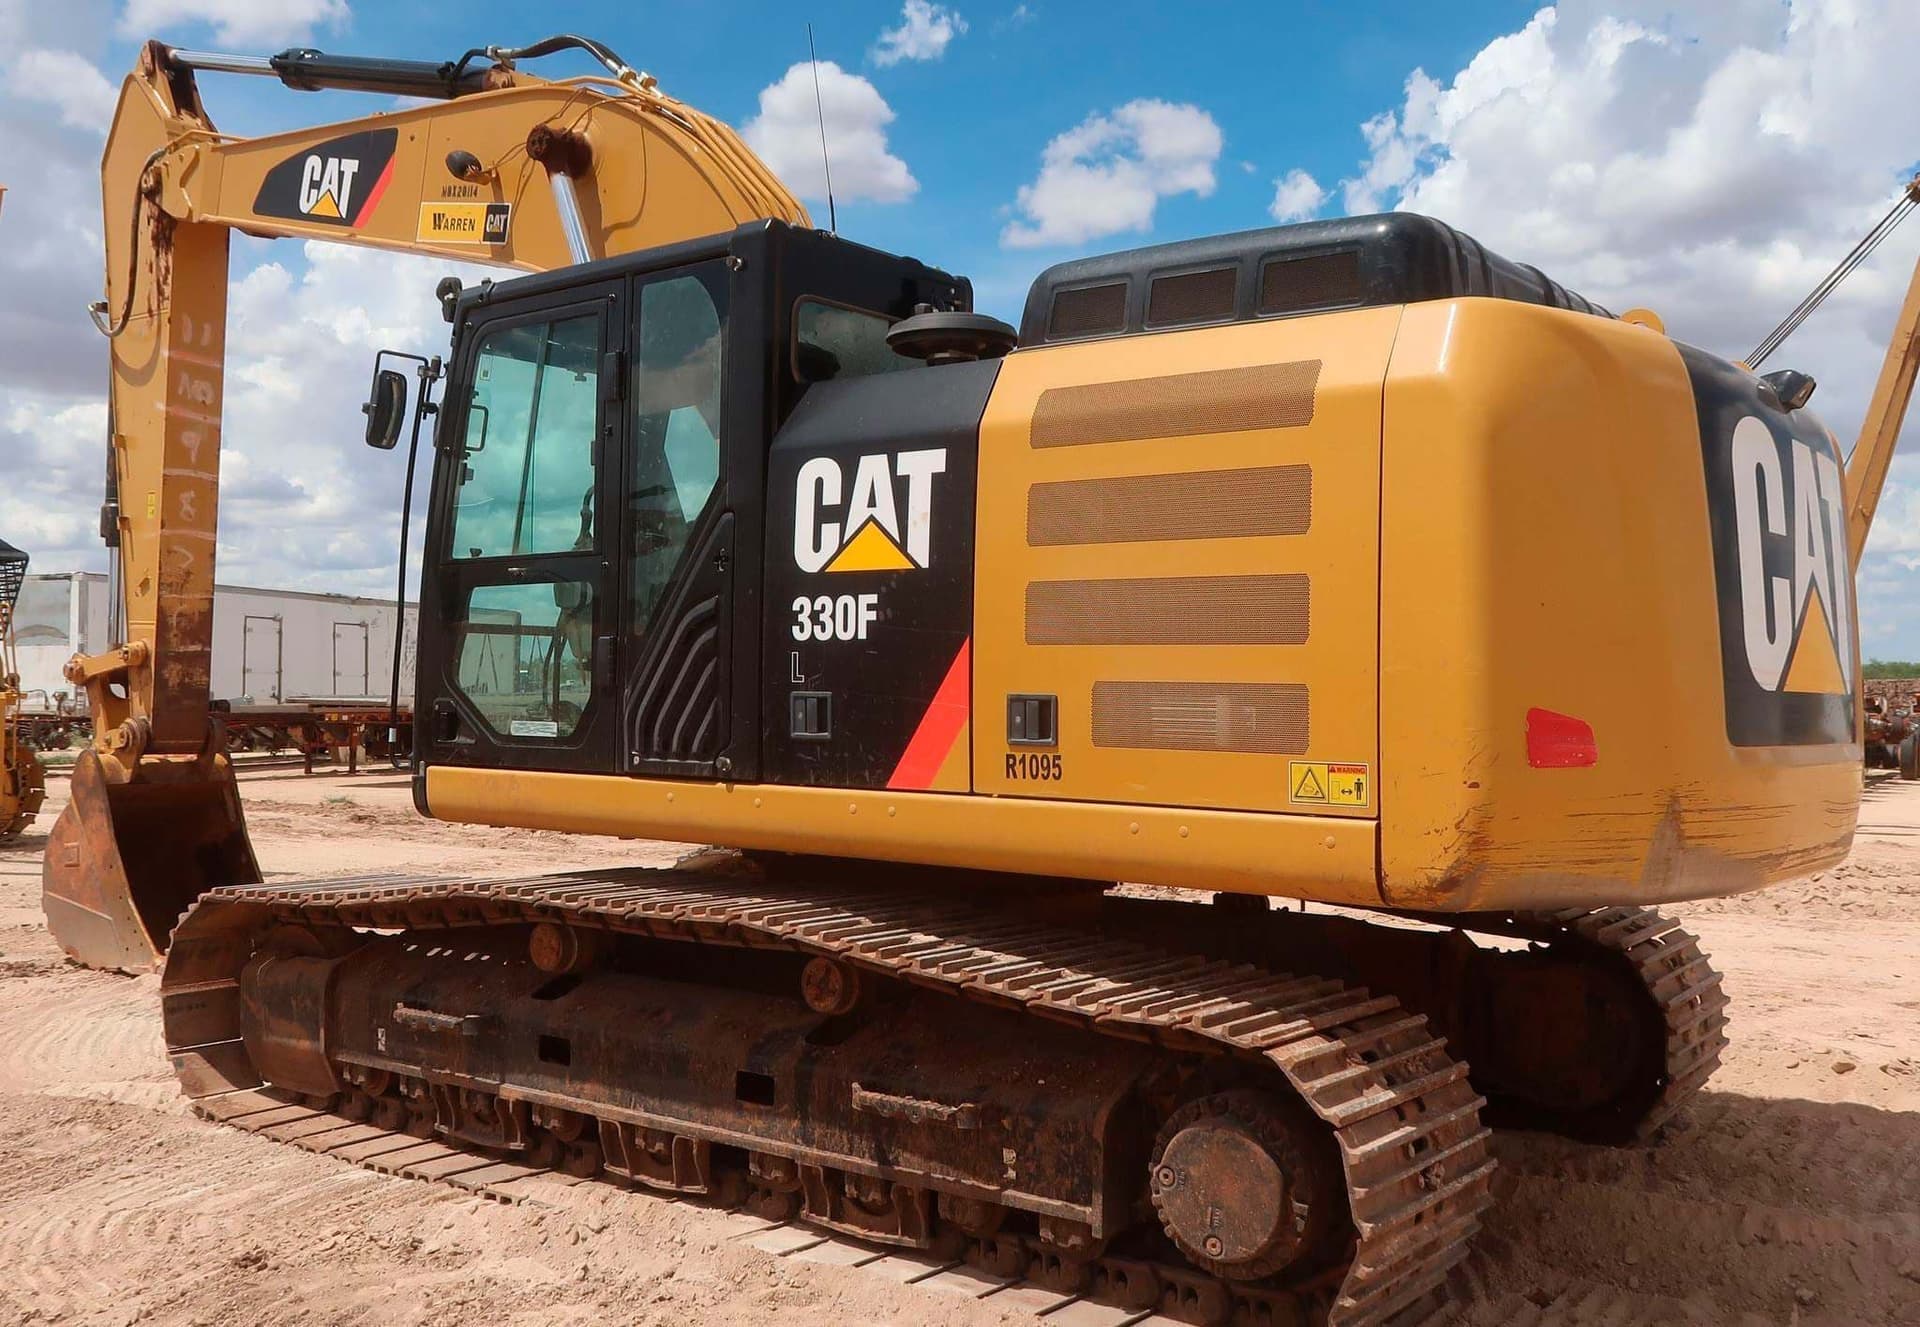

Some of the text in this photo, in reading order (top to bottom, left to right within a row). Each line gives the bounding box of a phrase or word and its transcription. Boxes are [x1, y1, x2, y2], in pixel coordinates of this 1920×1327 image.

[299, 154, 359, 218] CAT
[432, 213, 476, 232] WARREN
[486, 214, 508, 233] CAT
[794, 448, 947, 573] CAT
[1732, 415, 1851, 694] CAT
[791, 594, 878, 642] 330F
[791, 651, 805, 683] L
[1005, 753, 1063, 781] R1095
[1336, 766, 1366, 774] WARNING
